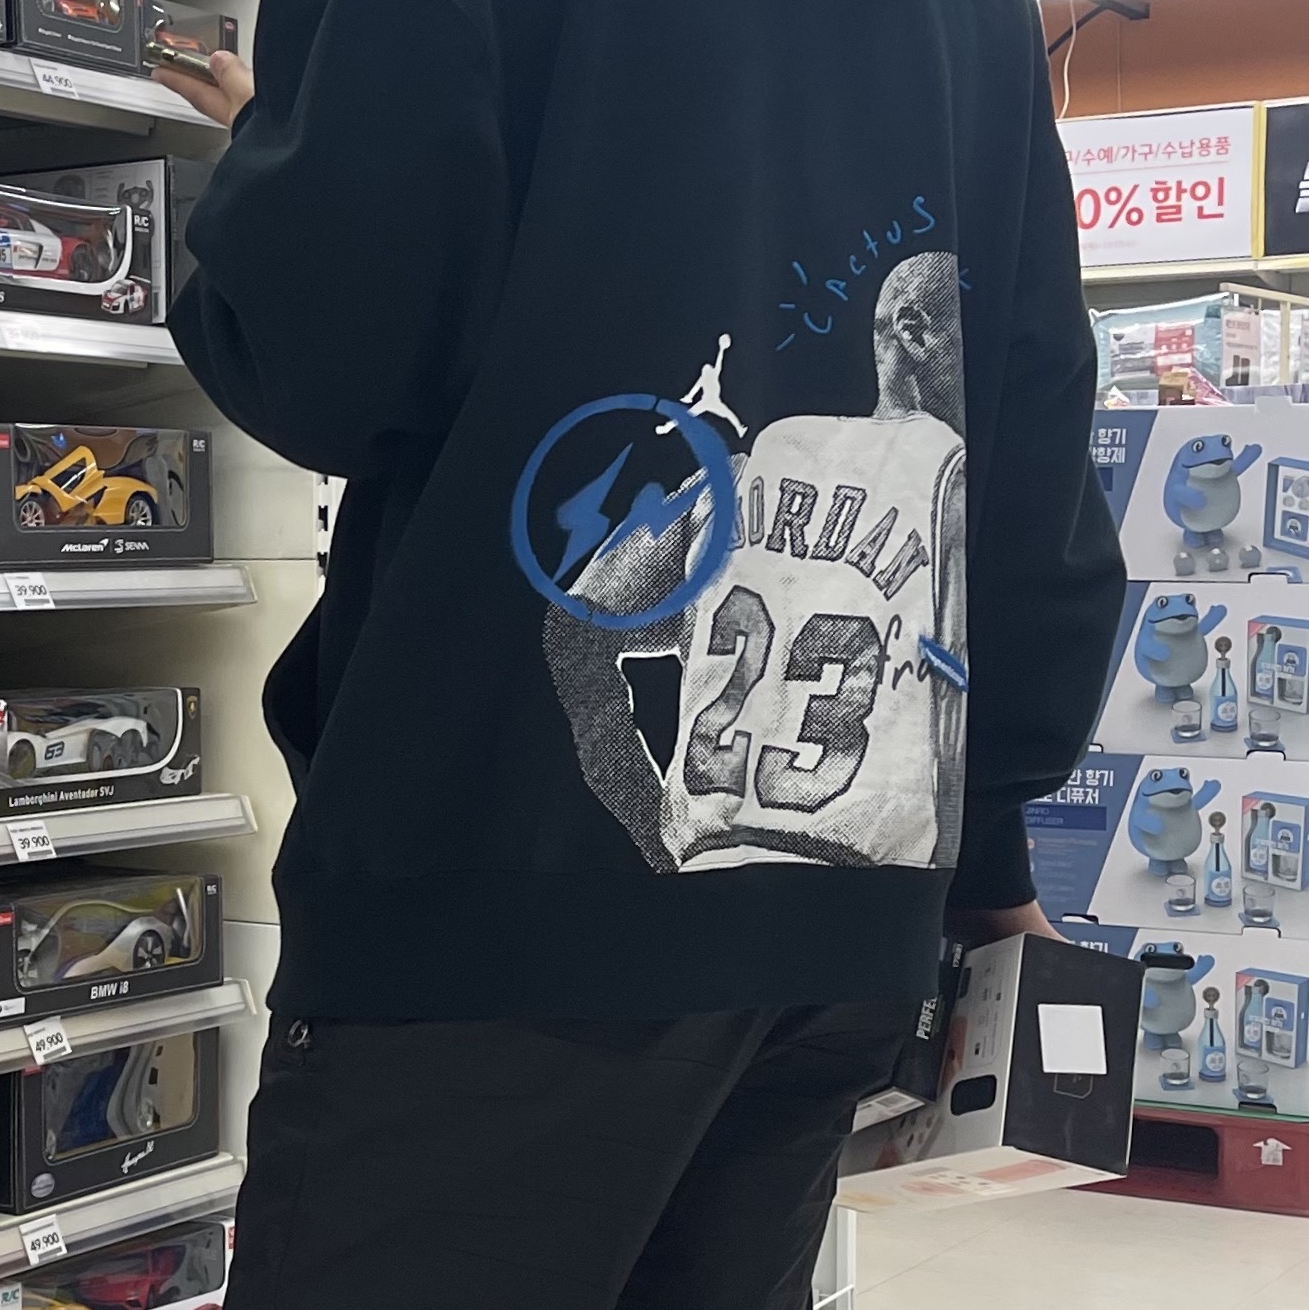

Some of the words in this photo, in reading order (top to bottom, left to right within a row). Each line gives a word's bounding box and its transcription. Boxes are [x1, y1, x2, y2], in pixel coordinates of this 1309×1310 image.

[41, 73, 73, 90] 44,900
[1076, 184, 1144, 230] 0%
[1150, 176, 1225, 223] 할인
[1098, 428, 1126, 445] 향기
[61, 541, 105, 553] McLaren
[15, 584, 47, 597] 39,900
[683, 585, 882, 813] 23
[1085, 768, 1114, 787] 향기
[8, 791, 58, 809] Lamborghini
[59, 787, 97, 802] Aventador
[99, 785, 115, 799] SVJ
[18, 834, 51, 850] 39,900
[90, 983, 116, 1000] BMW
[117, 981, 129, 995] i8
[915, 997, 938, 1041] PERFE
[34, 1031, 64, 1051] 49,900
[29, 1231, 61, 1252] 49,900
[0, 1288, 21, 1303] R/C
